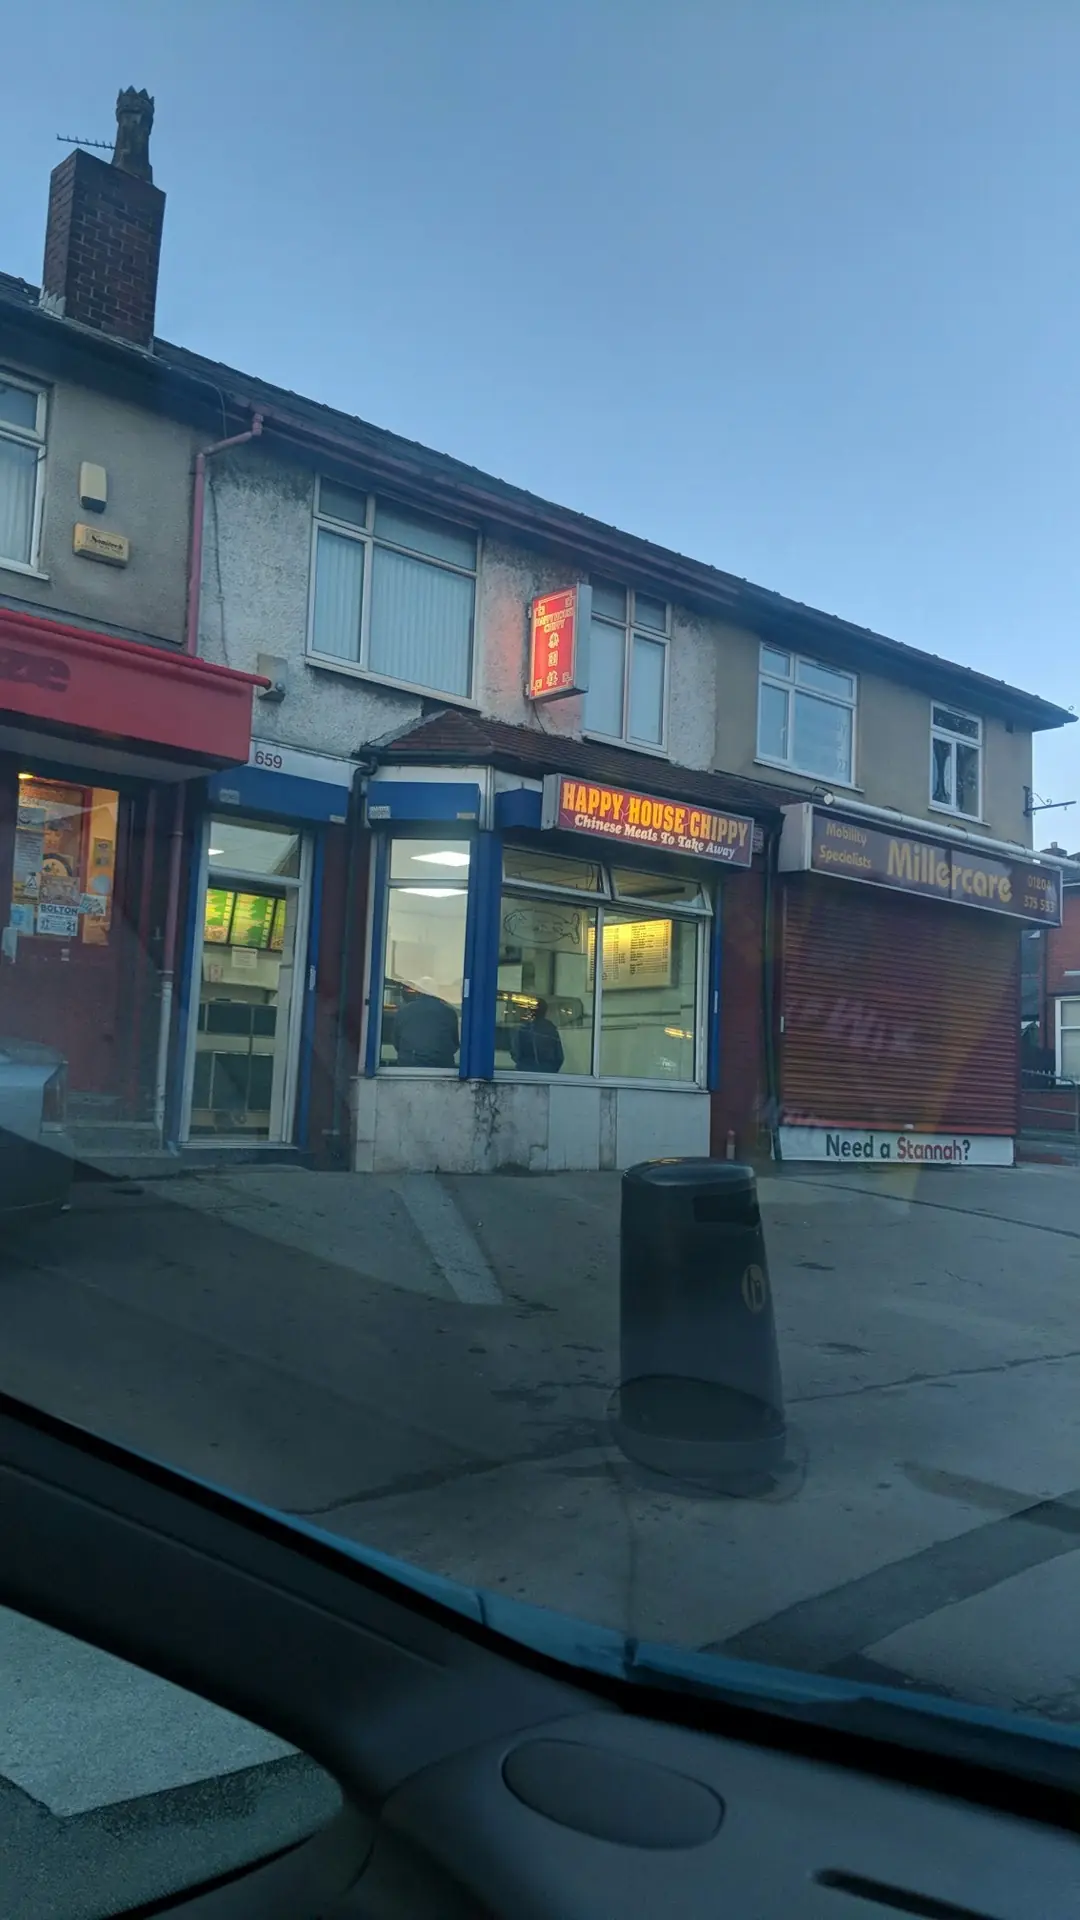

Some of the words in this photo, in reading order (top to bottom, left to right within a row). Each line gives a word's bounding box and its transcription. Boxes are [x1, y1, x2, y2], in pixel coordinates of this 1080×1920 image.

[254, 750, 283, 769] 659
[562, 782, 624, 820] HAPPY
[628, 796, 685, 834] HOUSE
[689, 811, 748, 847] CHIPPY
[574, 814, 622, 835] Chinese
[624, 824, 658, 842] Meals
[660, 832, 675, 846] To
[677, 835, 704, 854] Take
[705, 844, 736, 860] Away
[826, 822, 867, 847] Mobility
[819, 844, 872, 869] Specialists
[887, 839, 1013, 903] Millercare
[41, 904, 78, 916] BOLTON
[826, 1133, 873, 1159] Need
[880, 1142, 891, 1159] a
[897, 1136, 971, 1161] Stannah?
